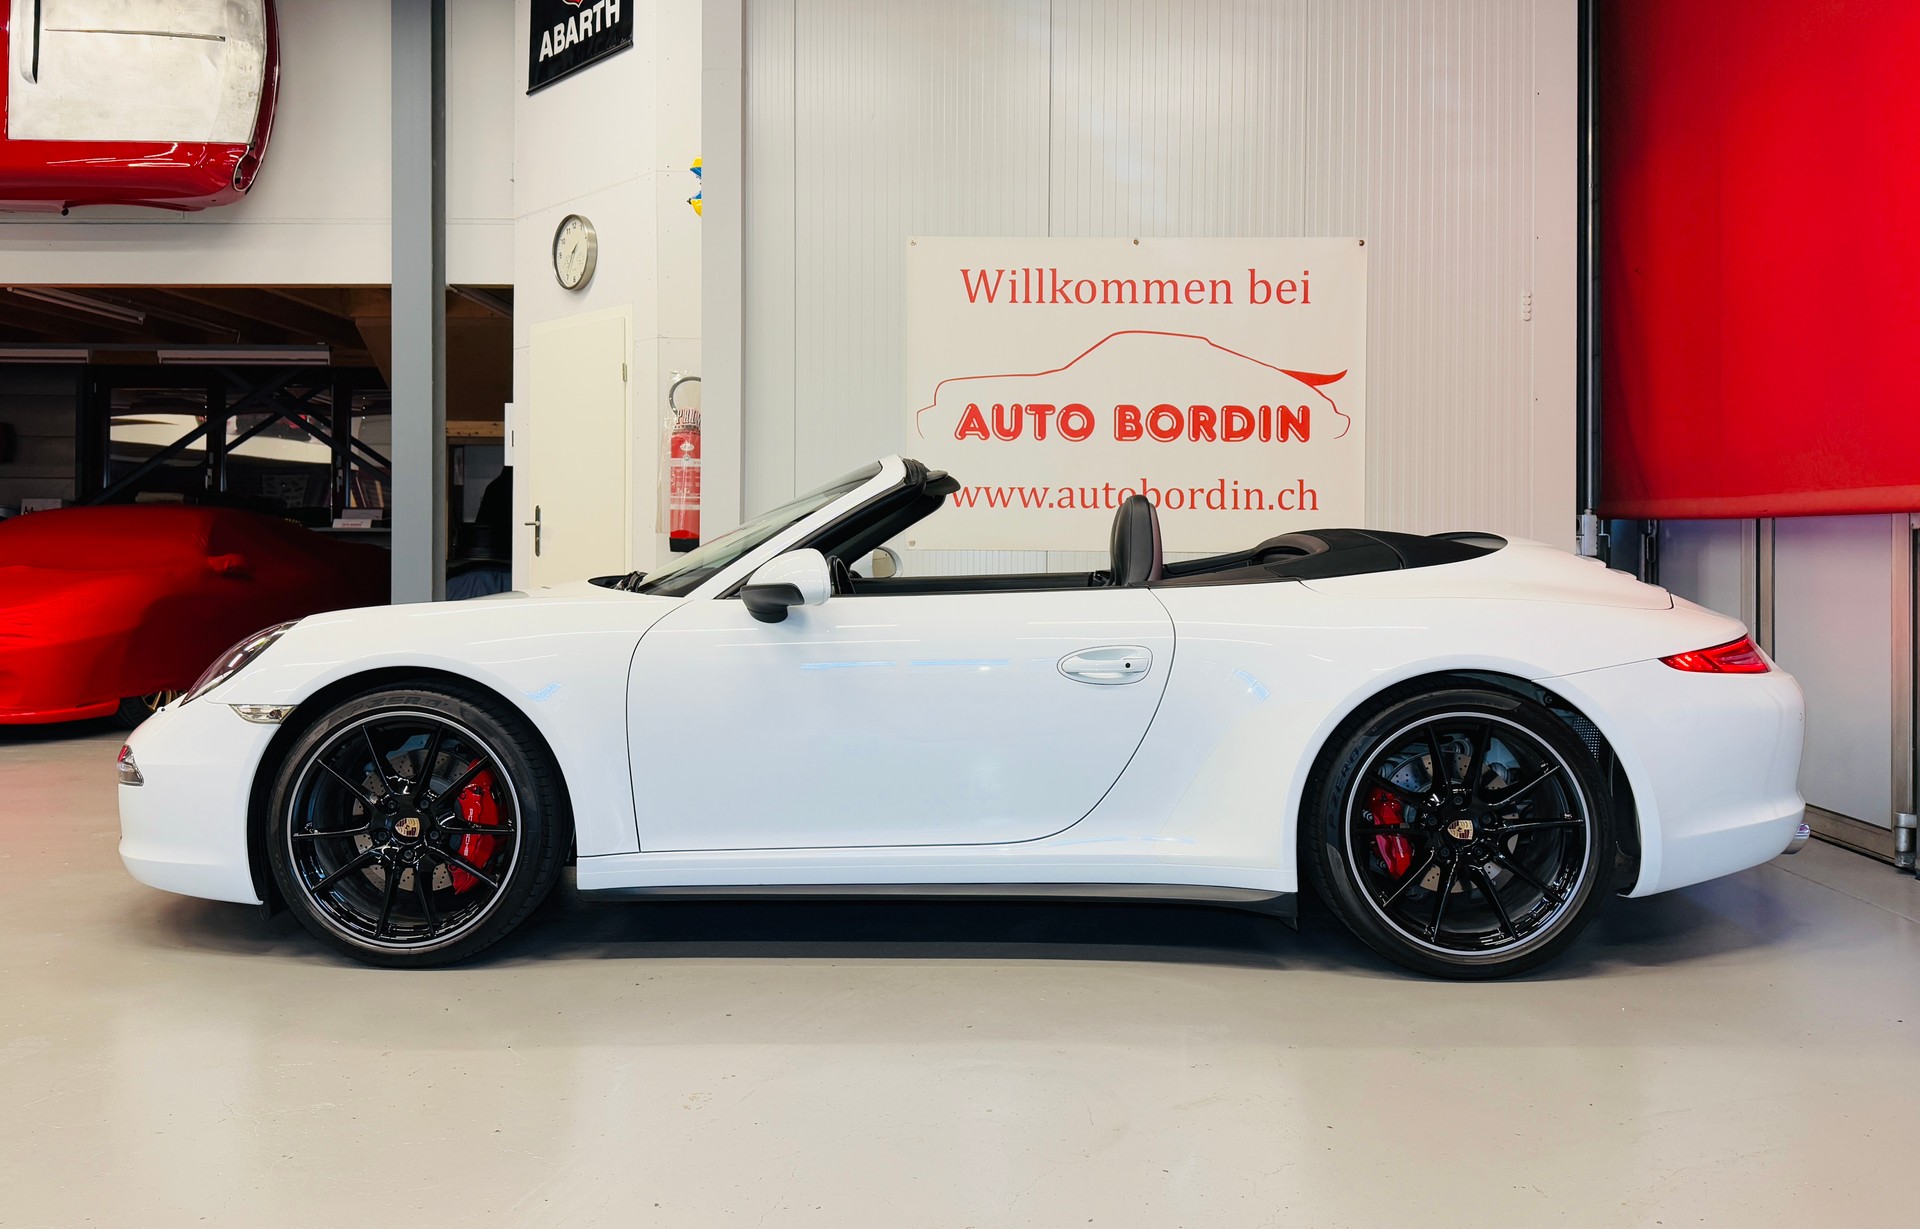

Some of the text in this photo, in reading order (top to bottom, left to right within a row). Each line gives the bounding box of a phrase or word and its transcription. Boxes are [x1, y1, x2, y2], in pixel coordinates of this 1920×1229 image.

[539, 0, 620, 62] ABARTH
[961, 268, 1310, 304] Willkommen bei
[954, 404, 1310, 443] AUTO BORDIN
